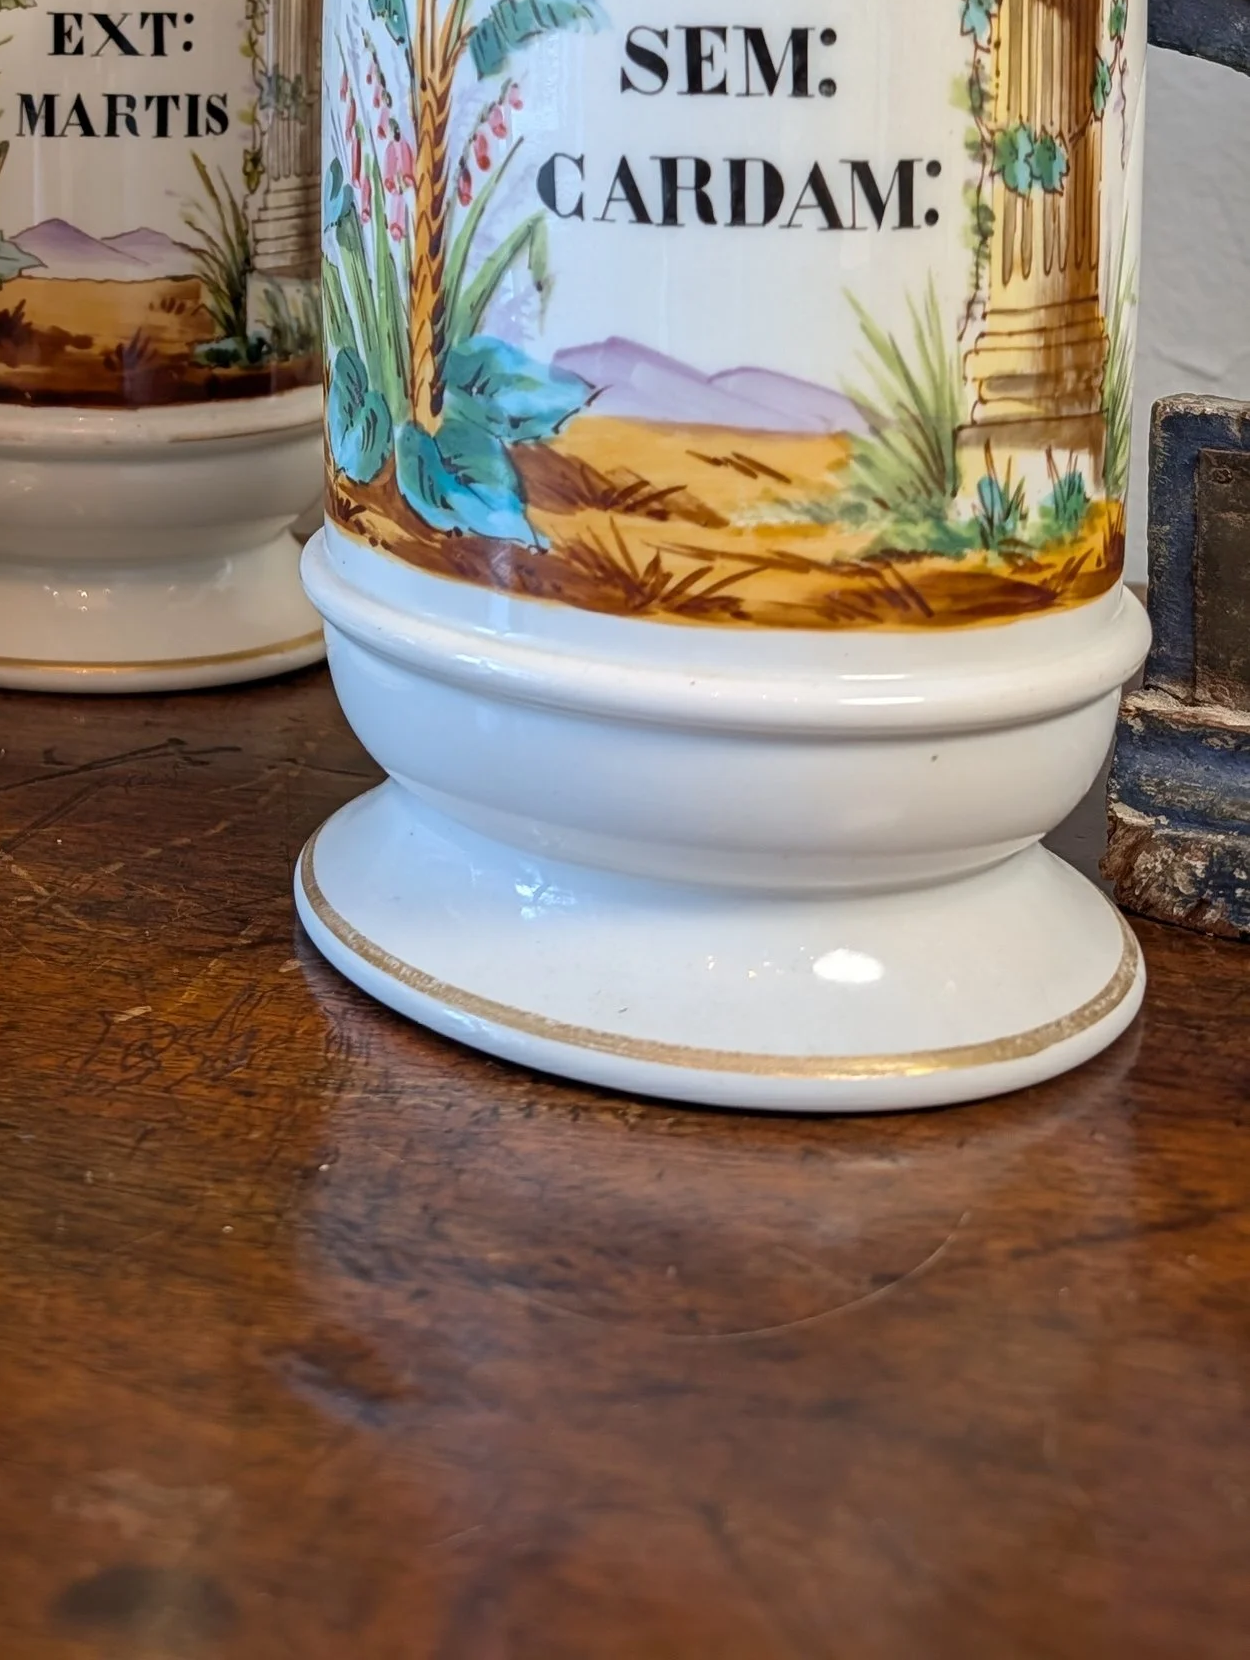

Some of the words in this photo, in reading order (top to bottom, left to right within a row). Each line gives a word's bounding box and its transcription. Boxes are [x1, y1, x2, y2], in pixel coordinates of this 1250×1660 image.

[47, 11, 194, 57] EXT:
[620, 25, 837, 98] SEM:
[15, 92, 229, 138] MARTIS
[536, 152, 942, 231] CARDAM:
